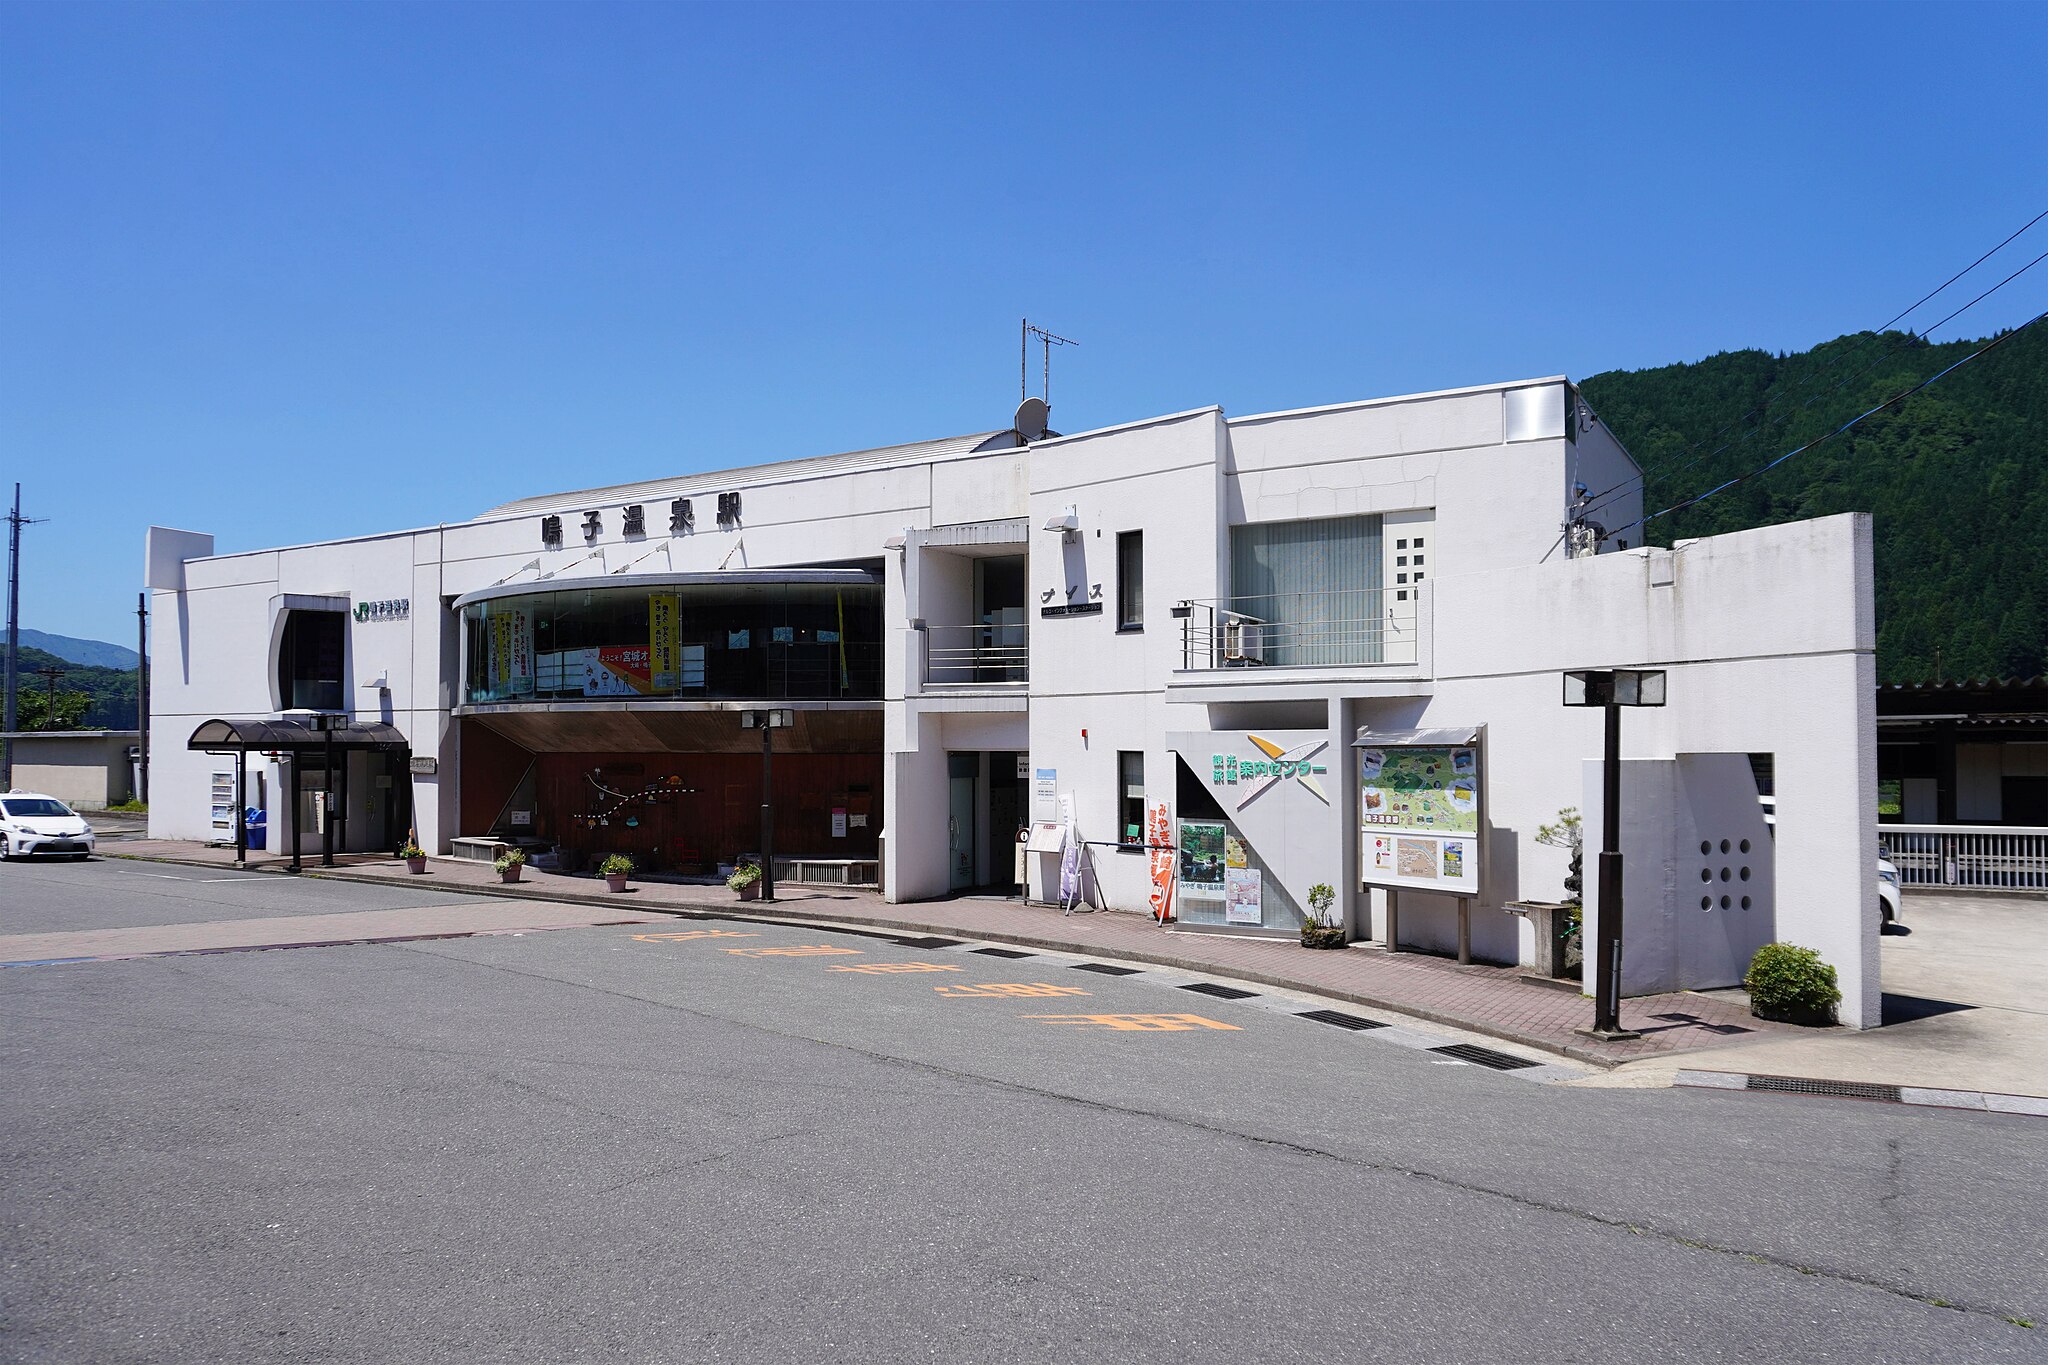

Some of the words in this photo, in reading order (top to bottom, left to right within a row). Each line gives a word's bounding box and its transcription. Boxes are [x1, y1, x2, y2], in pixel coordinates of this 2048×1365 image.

[541, 491, 742, 546] 鳴子温泉駅
[1040, 583, 1103, 604] ナイス
[353, 602, 370, 617] JR
[1042, 604, 1101, 614] ナルコ・インフォーション・ステーション
[1212, 754, 1237, 767] 観光
[1212, 769, 1237, 783] 旅館
[1240, 760, 1327, 778] 案内センター
[1157, 803, 1174, 869] みやぎ大崎
[1180, 882, 1195, 890] みやぎ
